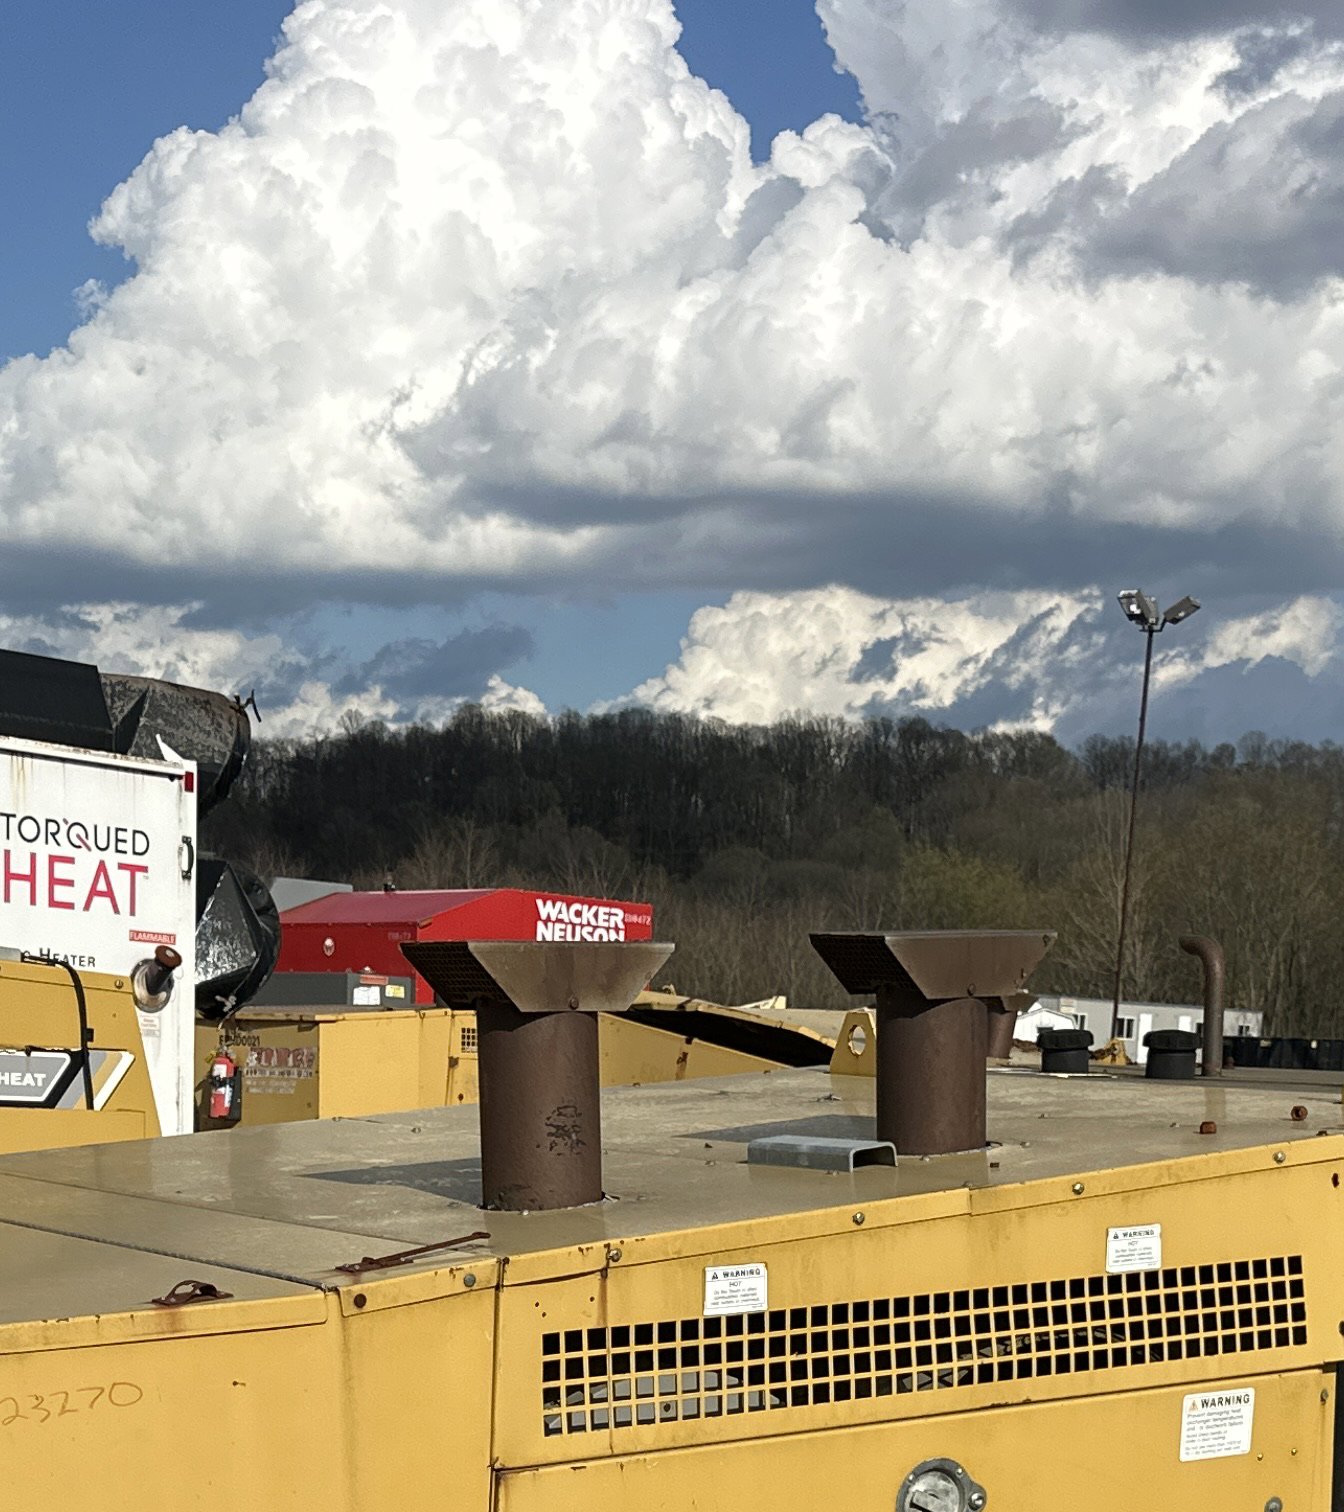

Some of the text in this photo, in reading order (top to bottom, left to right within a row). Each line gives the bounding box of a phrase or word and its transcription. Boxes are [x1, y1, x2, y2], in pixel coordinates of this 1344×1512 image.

[0, 812, 150, 856] TORQUED
[3, 849, 149, 917] HEAT
[536, 898, 625, 929] WACKER
[722, 1268, 761, 1279] WARNING
[1200, 1393, 1250, 1409] WARNING
